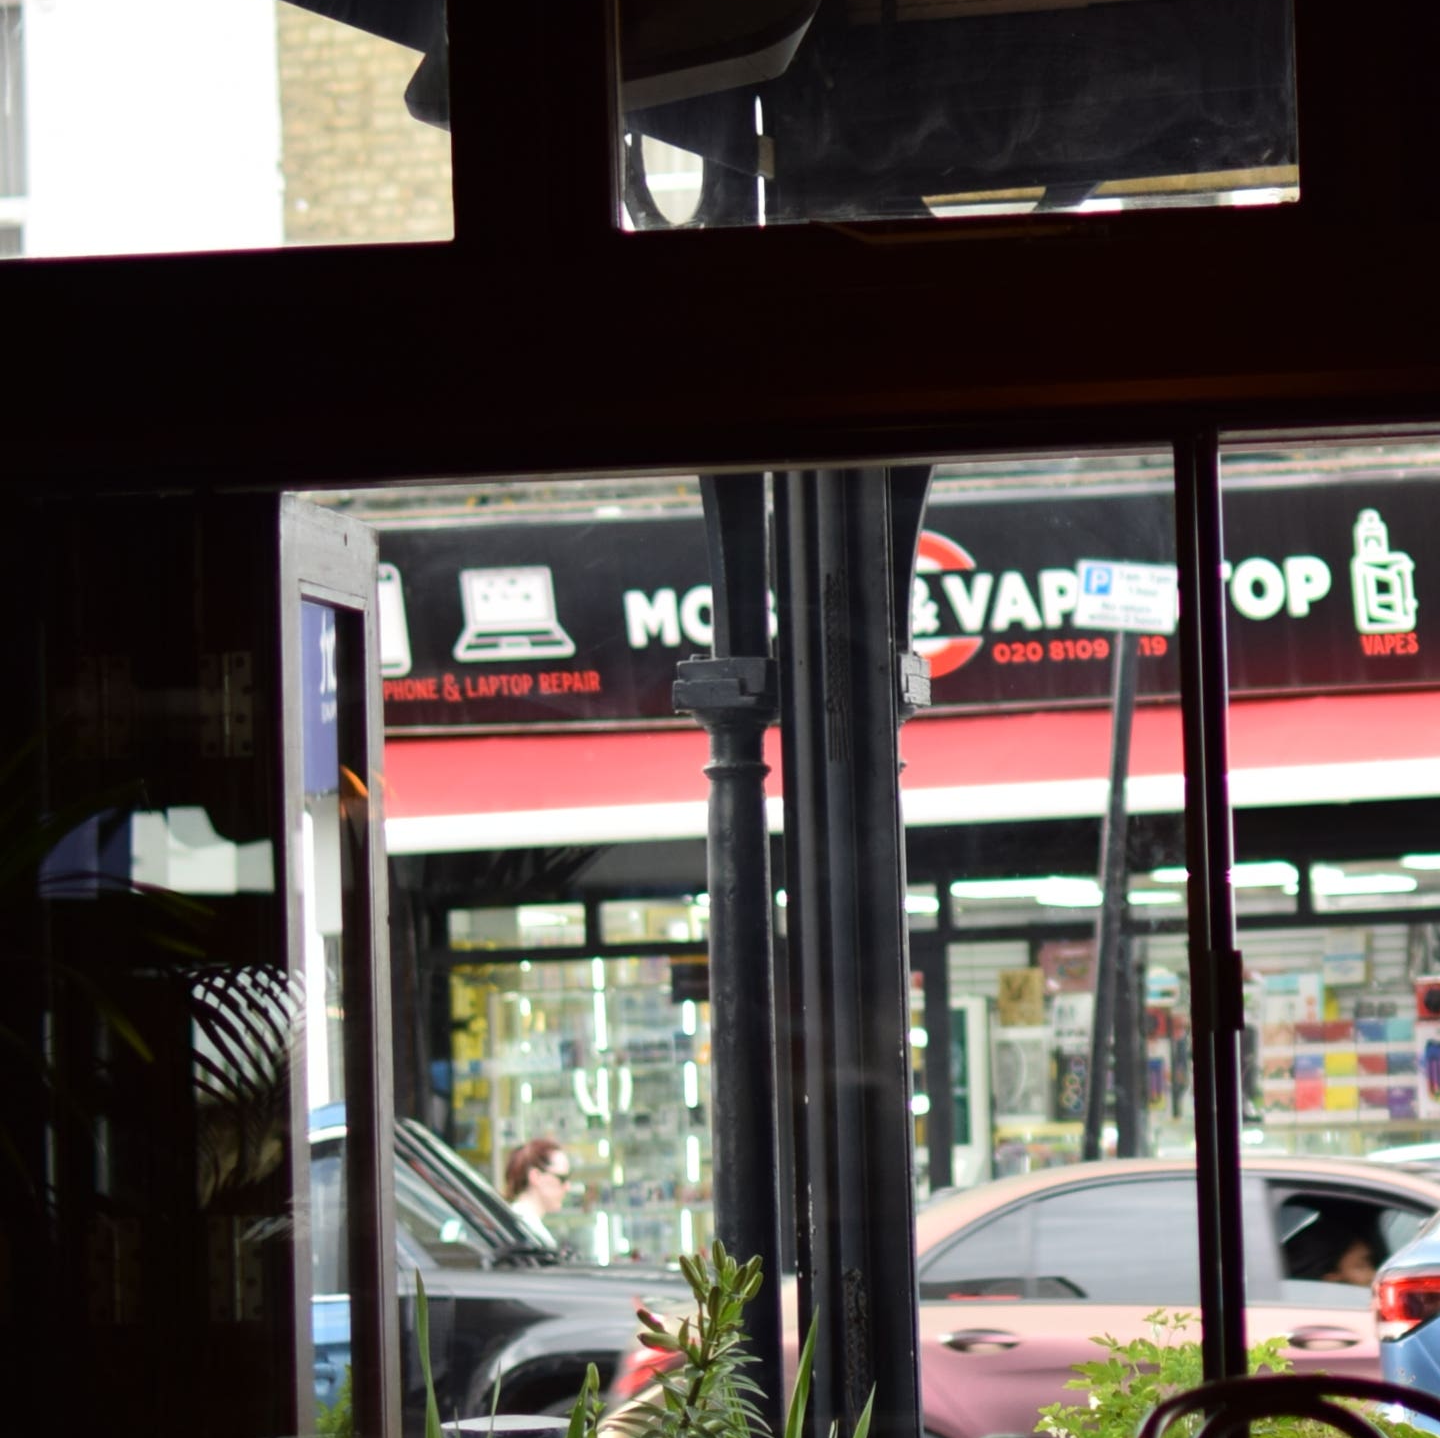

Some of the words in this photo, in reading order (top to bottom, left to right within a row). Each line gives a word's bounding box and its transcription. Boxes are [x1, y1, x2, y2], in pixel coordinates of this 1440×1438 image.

[992, 641, 1044, 663] 020
[1049, 638, 1109, 661] 8109
[1360, 632, 1419, 655] VAPES
[383, 677, 438, 702] PHONE
[443, 671, 462, 702] &
[465, 674, 533, 698] LAPTOP
[539, 670, 601, 694] REPAIR
